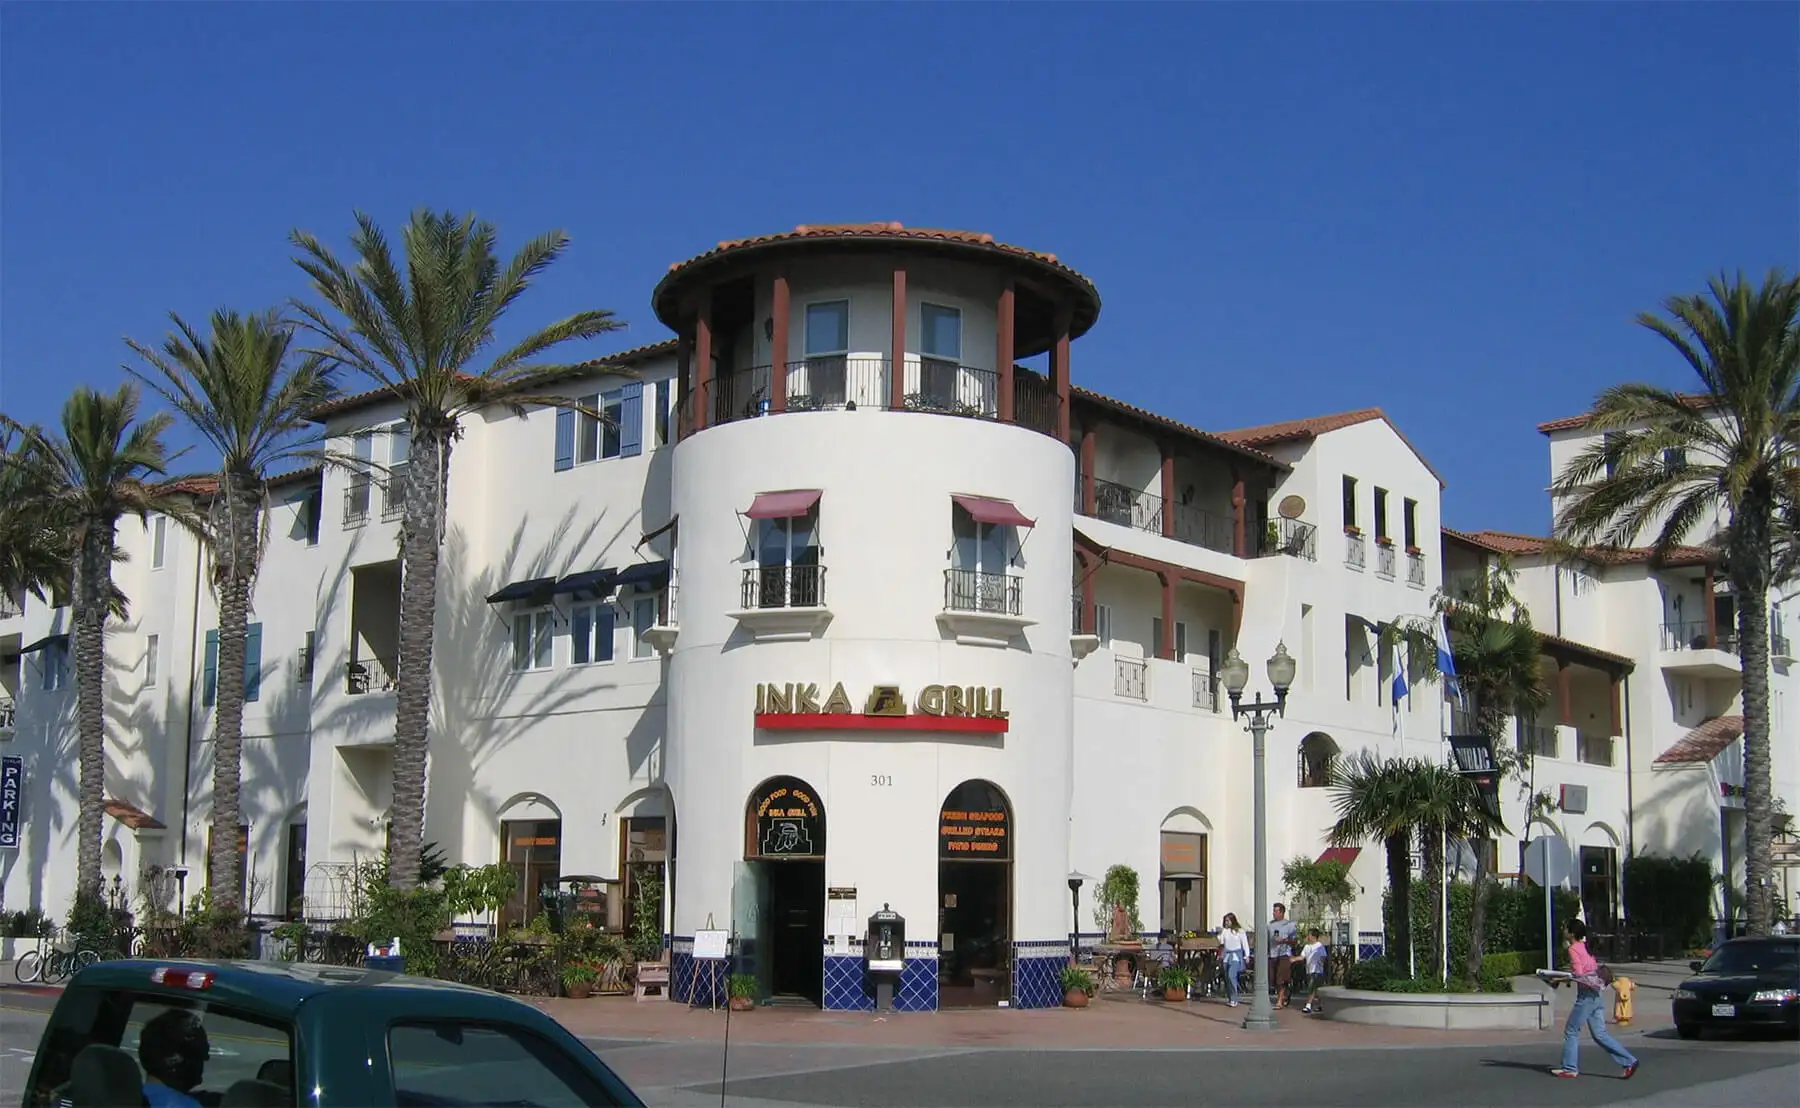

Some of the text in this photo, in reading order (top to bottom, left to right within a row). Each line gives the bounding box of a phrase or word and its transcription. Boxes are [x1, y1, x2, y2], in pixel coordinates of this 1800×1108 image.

[755, 681, 1009, 718] INKA GRILL
[871, 775, 893, 787] 301
[769, 788, 787, 801] FOOD
[792, 790, 810, 803] GOOD
[1, 767, 17, 843] PARKING
